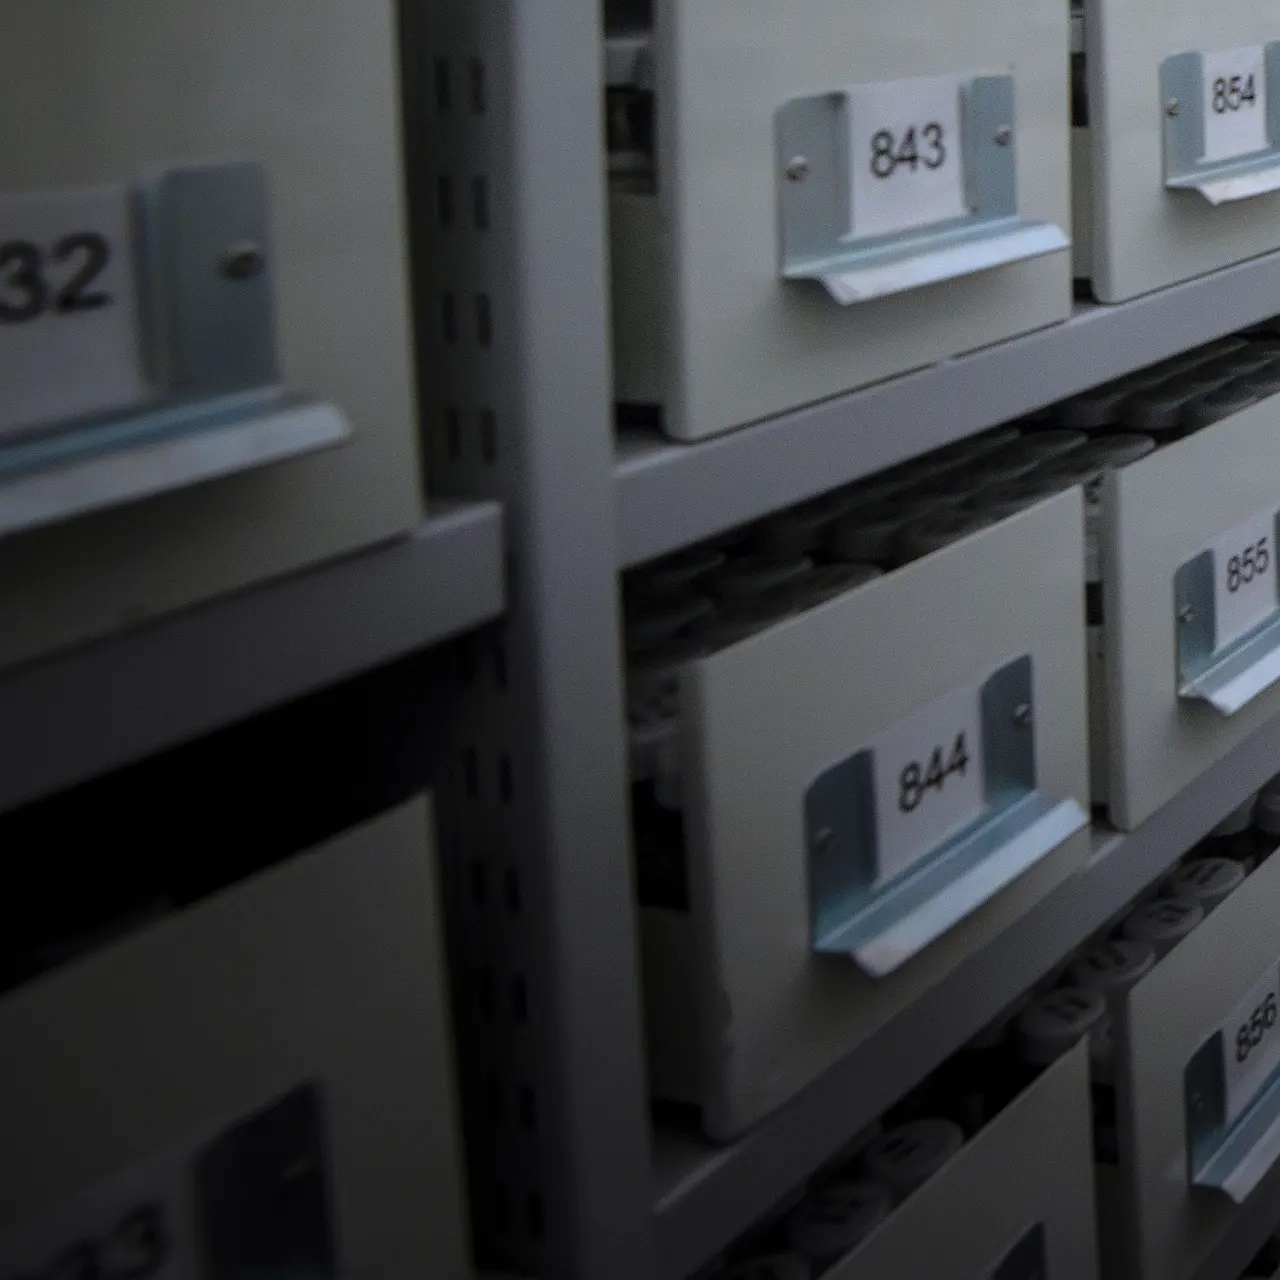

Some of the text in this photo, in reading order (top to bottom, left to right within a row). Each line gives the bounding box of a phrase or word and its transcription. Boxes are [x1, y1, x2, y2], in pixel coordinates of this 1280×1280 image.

[1212, 72, 1257, 116] 854
[870, 121, 947, 180] 843
[1225, 539, 1270, 595] 855
[898, 728, 972, 814] 844
[1234, 991, 1280, 1065] 856
